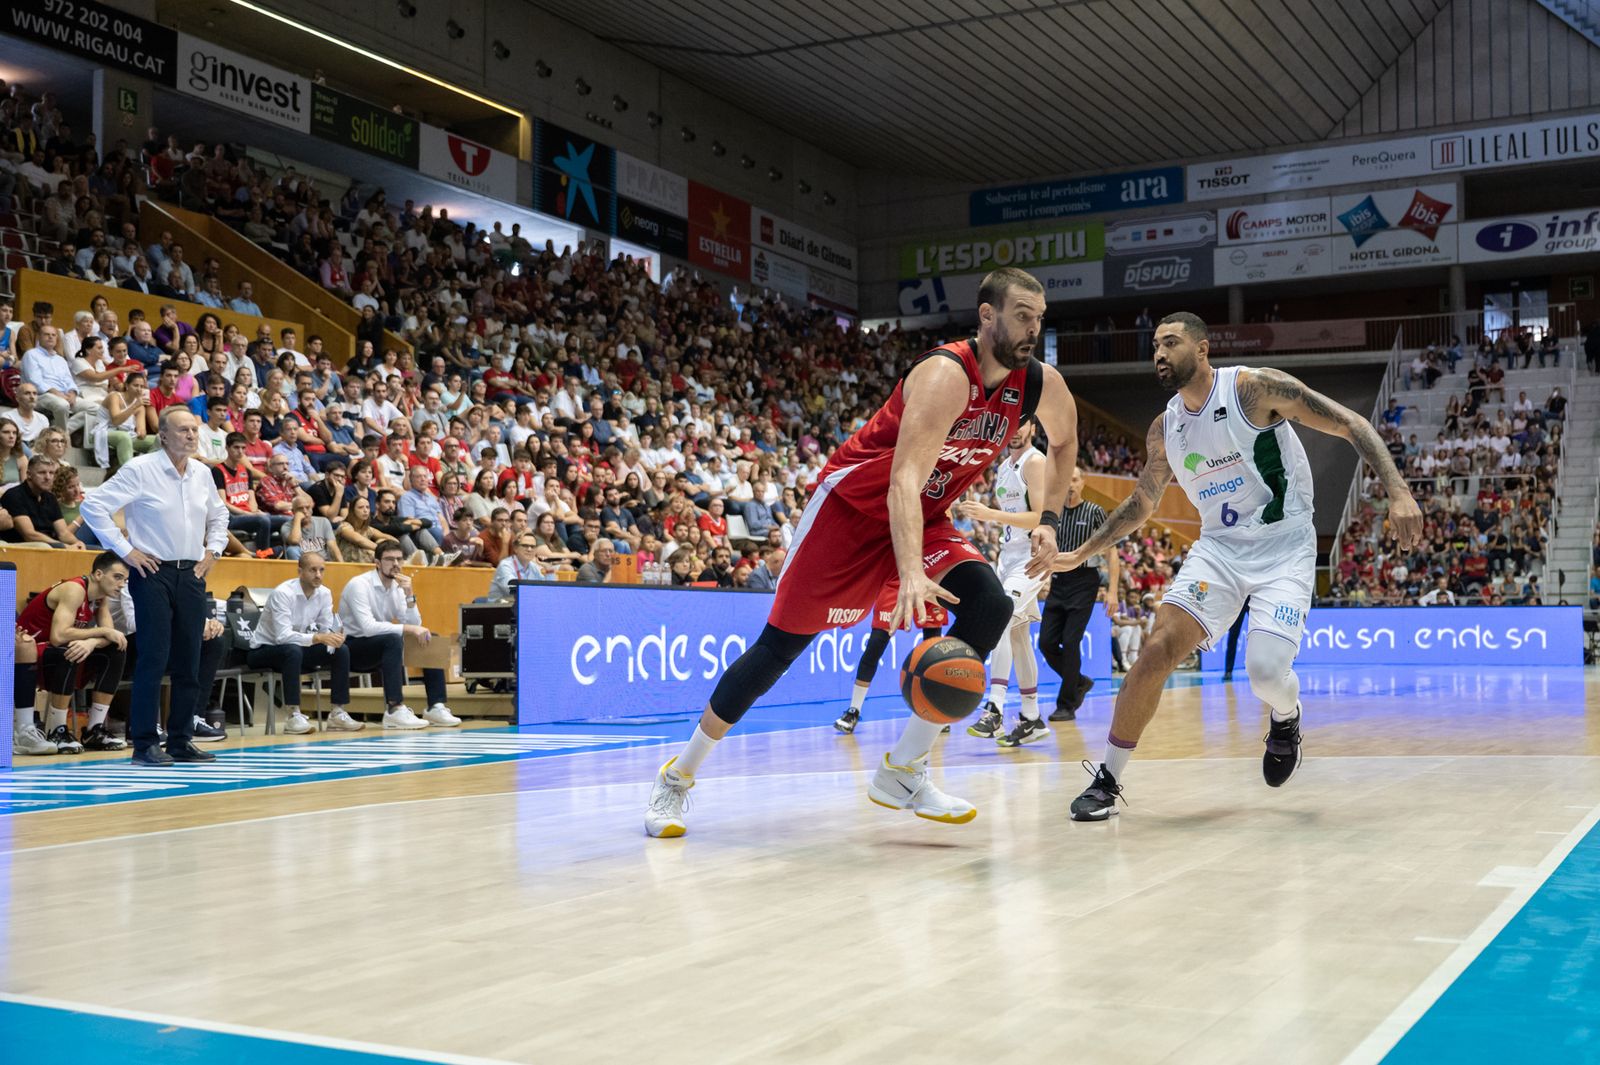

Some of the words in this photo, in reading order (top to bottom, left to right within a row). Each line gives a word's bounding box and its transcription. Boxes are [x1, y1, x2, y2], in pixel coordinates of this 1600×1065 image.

[44, 0, 74, 20] 972
[79, 7, 109, 32] 202
[113, 20, 143, 43] 004
[11, 8, 165, 75] WWW.RIGAU.CAT
[189, 51, 302, 113] ginvest
[219, 92, 245, 104] ASSET
[248, 101, 301, 123] MANAGEMENT
[351, 111, 405, 159] solideo
[1468, 132, 1532, 165] LLEAL
[1541, 122, 1599, 156] TULS
[1352, 151, 1416, 167] PereQuera
[448, 172, 470, 186] TEISA
[1120, 175, 1169, 202] ara
[1197, 174, 1250, 189] TISSOT
[1051, 182, 1107, 200] periodisme
[1243, 218, 1282, 231] CAMPS
[1286, 213, 1327, 226] MOTOR
[1349, 208, 1372, 226] ibis
[1410, 202, 1440, 225] ibis
[1545, 212, 1600, 238] inf
[634, 216, 659, 236] neorg
[699, 236, 742, 264] ESTRELLA
[779, 229, 804, 252] Diari
[807, 240, 819, 258] de
[821, 246, 852, 270] Girona
[1350, 250, 1389, 262] HOTEL
[1393, 245, 1440, 258] GIRONA
[1544, 235, 1597, 254] group
[1048, 276, 1082, 290] Brava
[1124, 263, 1191, 283] DISPUIG
[1198, 476, 1244, 500] málaga
[1221, 502, 1239, 527] 6
[929, 549, 950, 567] Home
[826, 608, 866, 624] YOSOY
[1414, 625, 1547, 650] endesa
